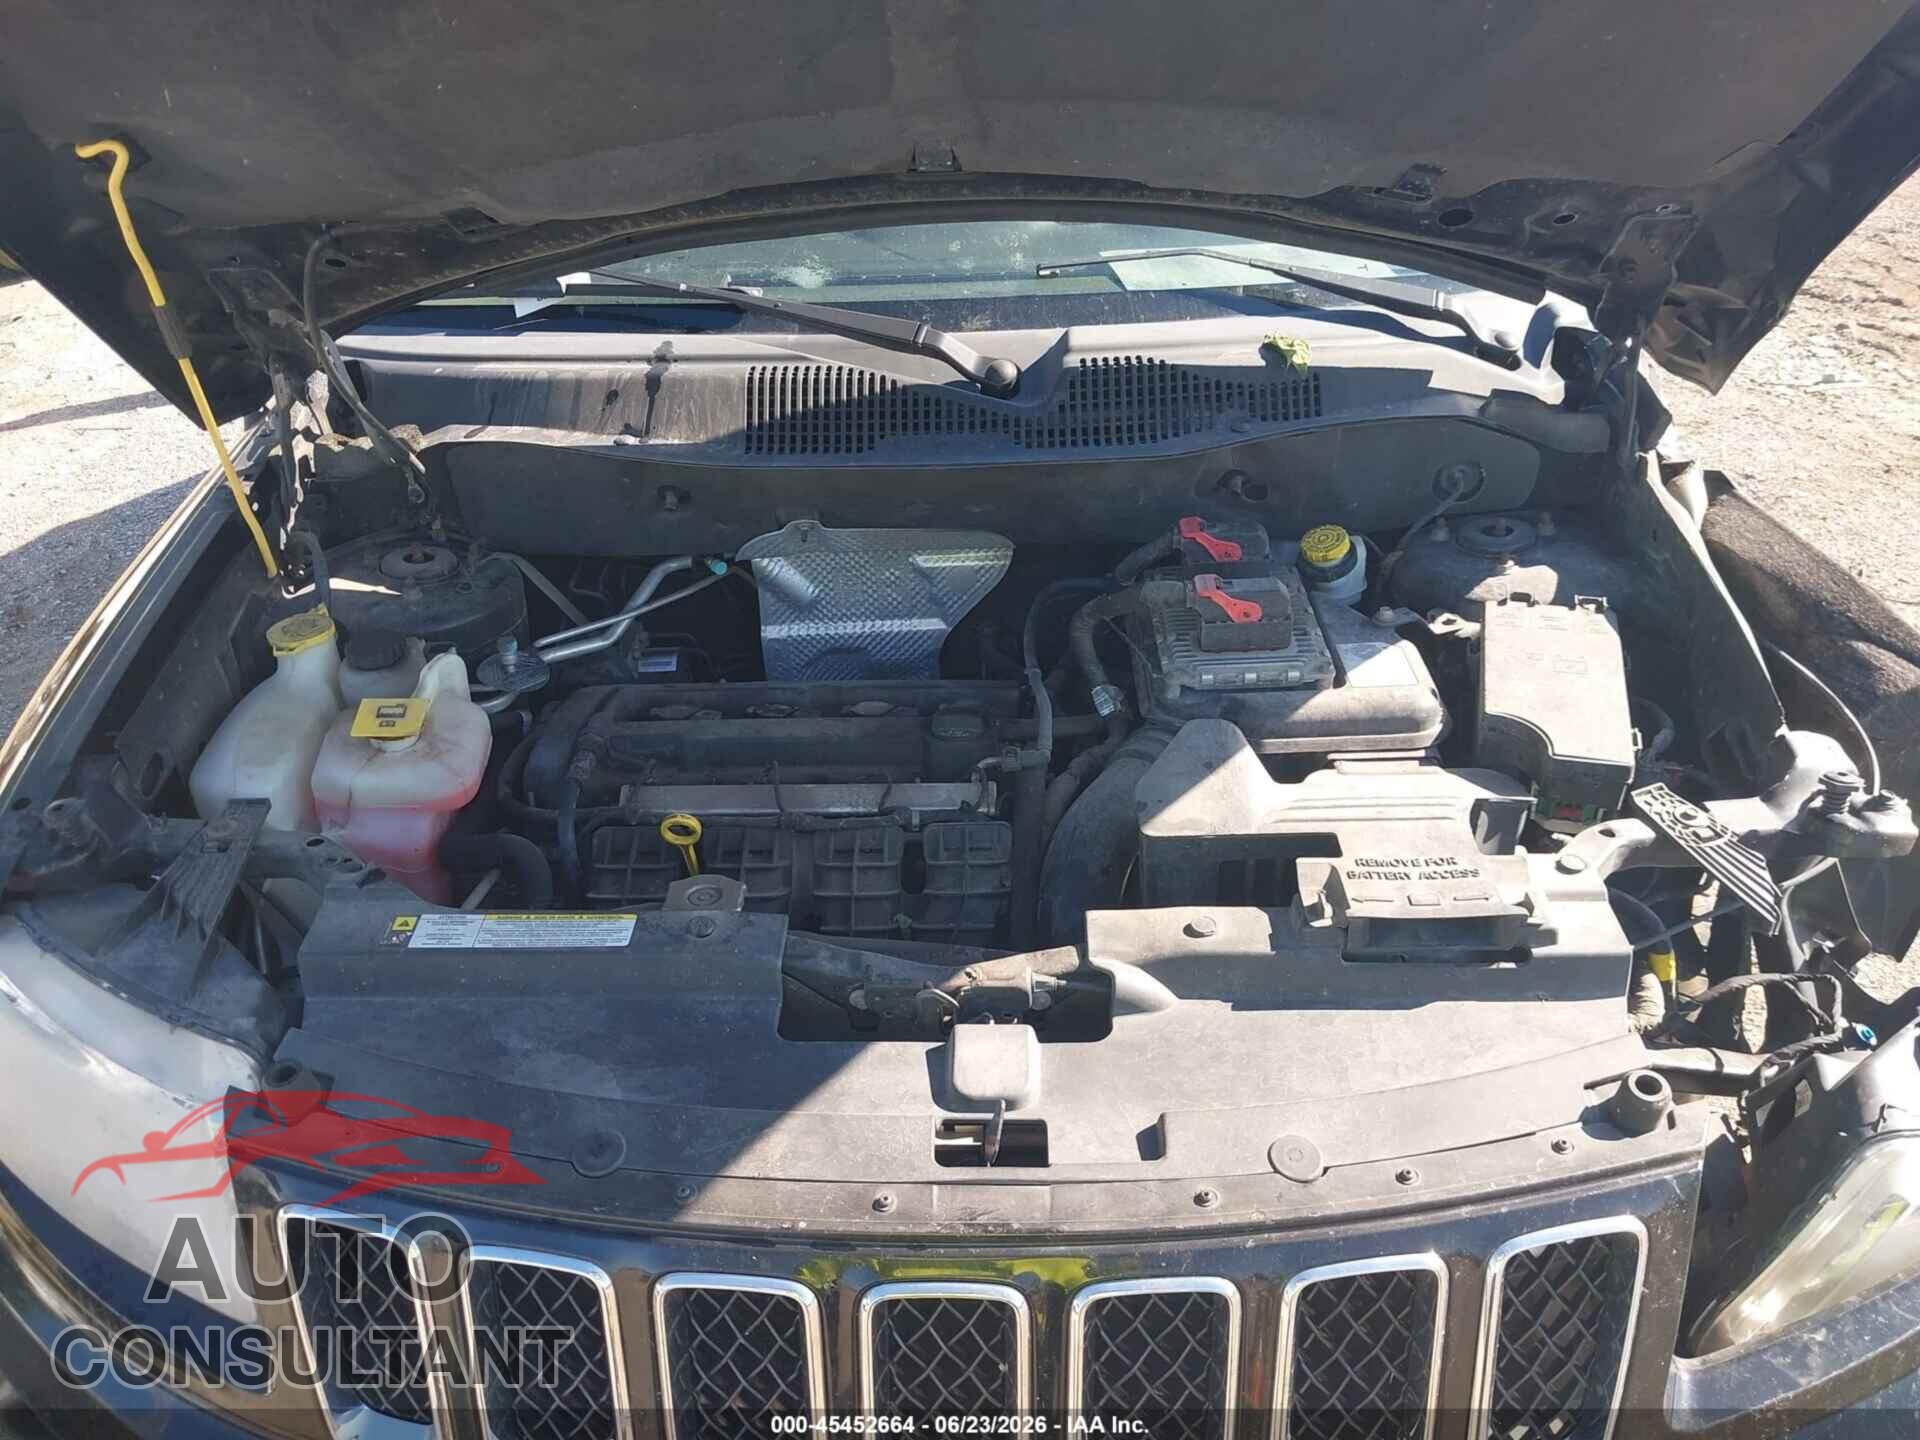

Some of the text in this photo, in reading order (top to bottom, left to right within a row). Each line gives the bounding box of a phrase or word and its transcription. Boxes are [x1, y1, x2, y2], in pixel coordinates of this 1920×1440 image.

[1354, 857, 1458, 867] REMOVE FOR
[1346, 869, 1480, 880] BATTERY ACCESS
